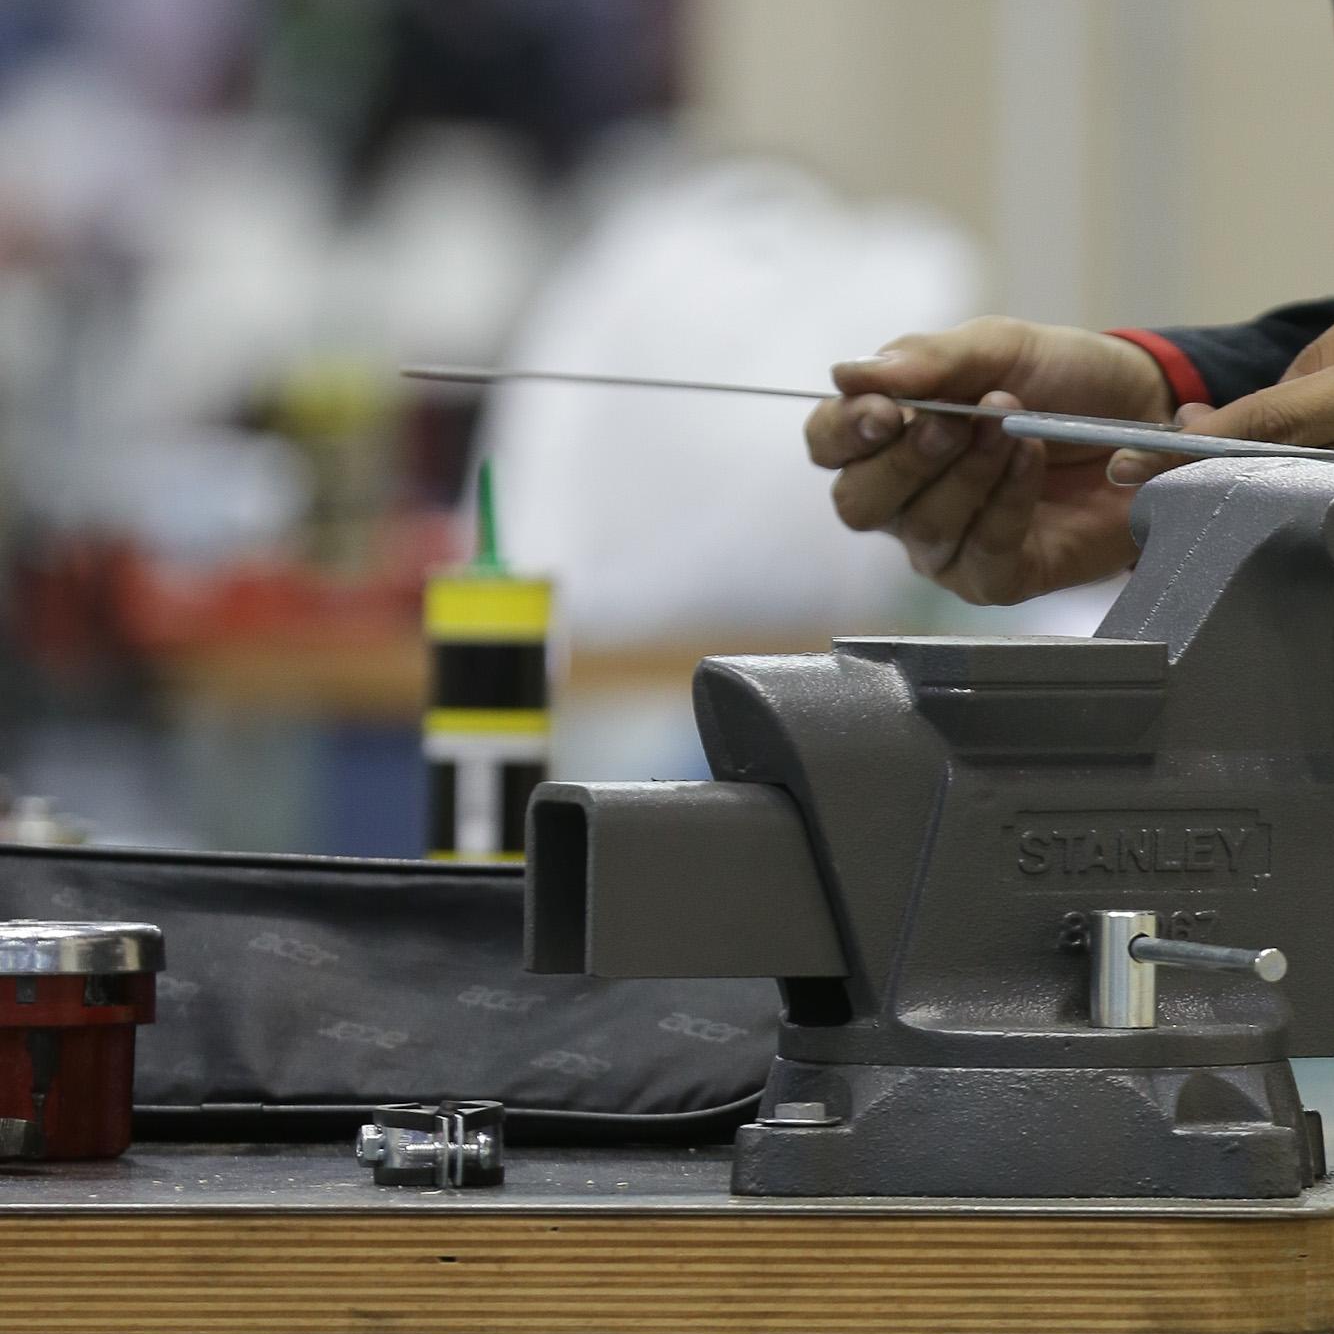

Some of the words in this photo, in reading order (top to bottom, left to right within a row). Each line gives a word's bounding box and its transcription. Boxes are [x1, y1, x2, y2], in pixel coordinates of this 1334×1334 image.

[1017, 828, 1249, 876] STANLEY
[248, 931, 340, 966] acer
[456, 984, 547, 1013] acer
[657, 1011, 749, 1045] acer
